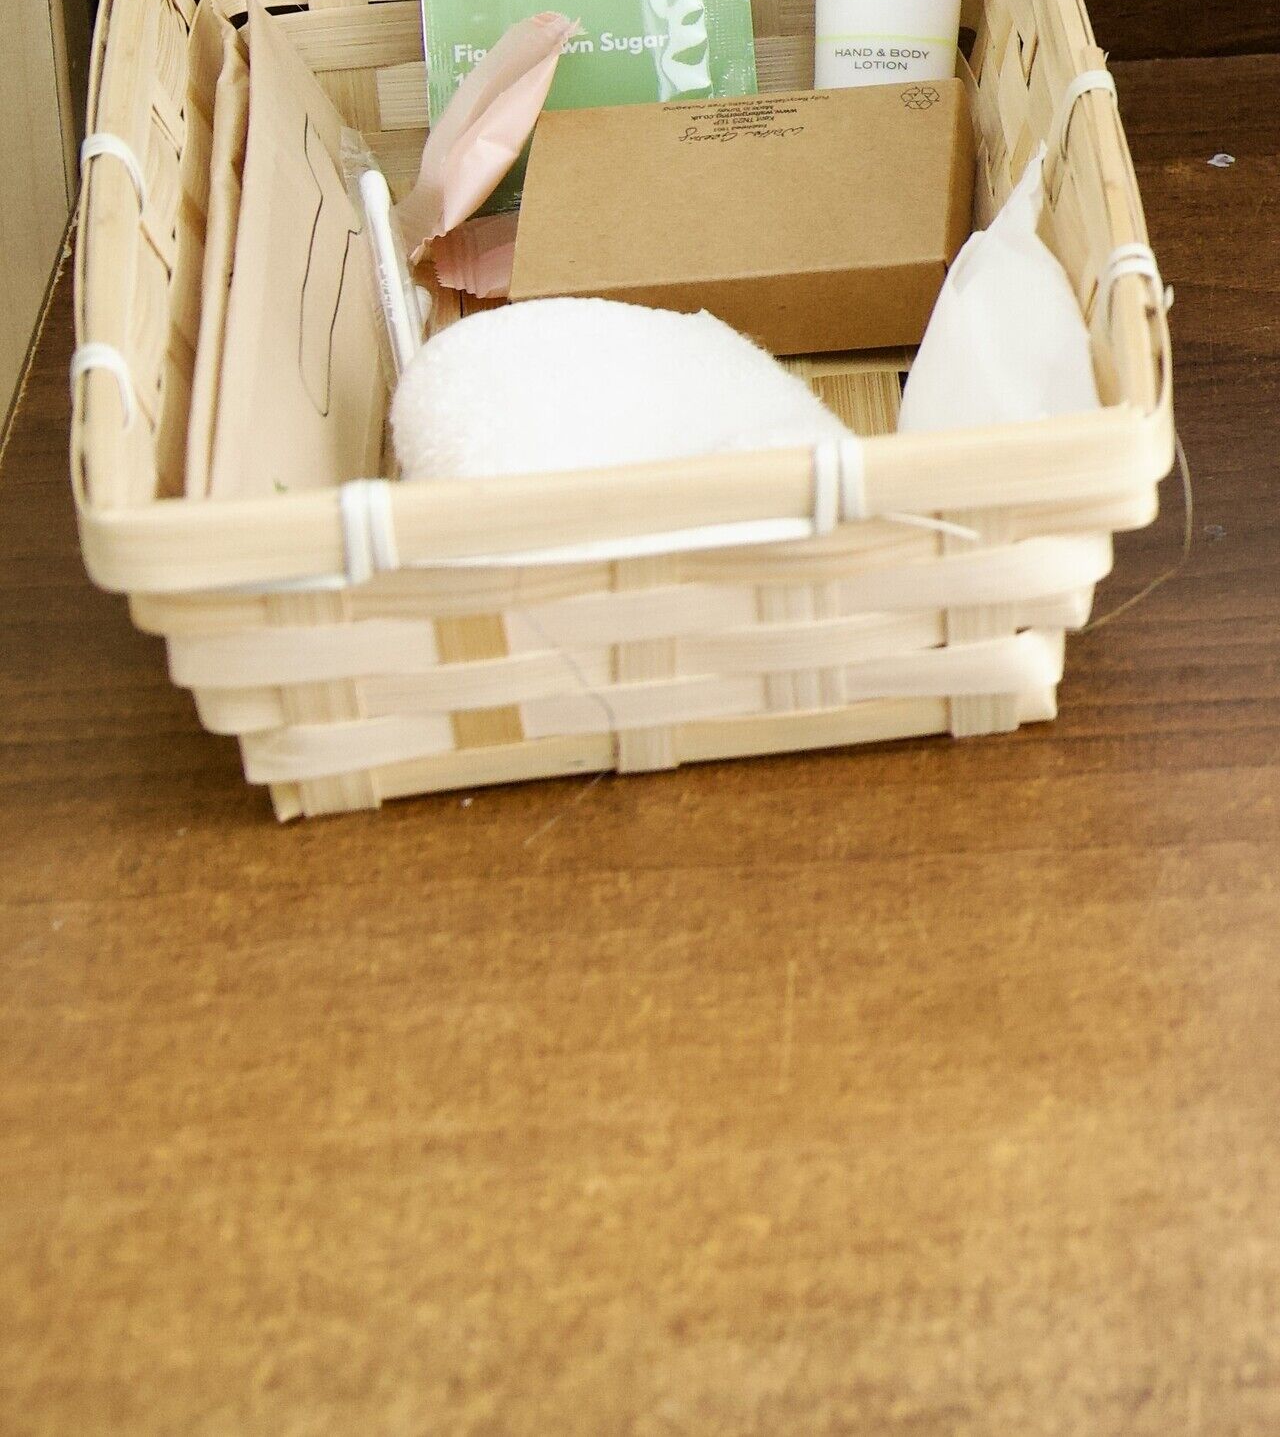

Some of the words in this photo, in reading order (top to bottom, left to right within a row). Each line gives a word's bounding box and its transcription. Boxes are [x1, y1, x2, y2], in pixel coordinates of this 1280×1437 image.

[599, 32, 668, 55] Sugar
[834, 48, 873, 59] HAND
[876, 48, 886, 58] &
[890, 48, 930, 60] BODY
[854, 59, 908, 71] LOTION
